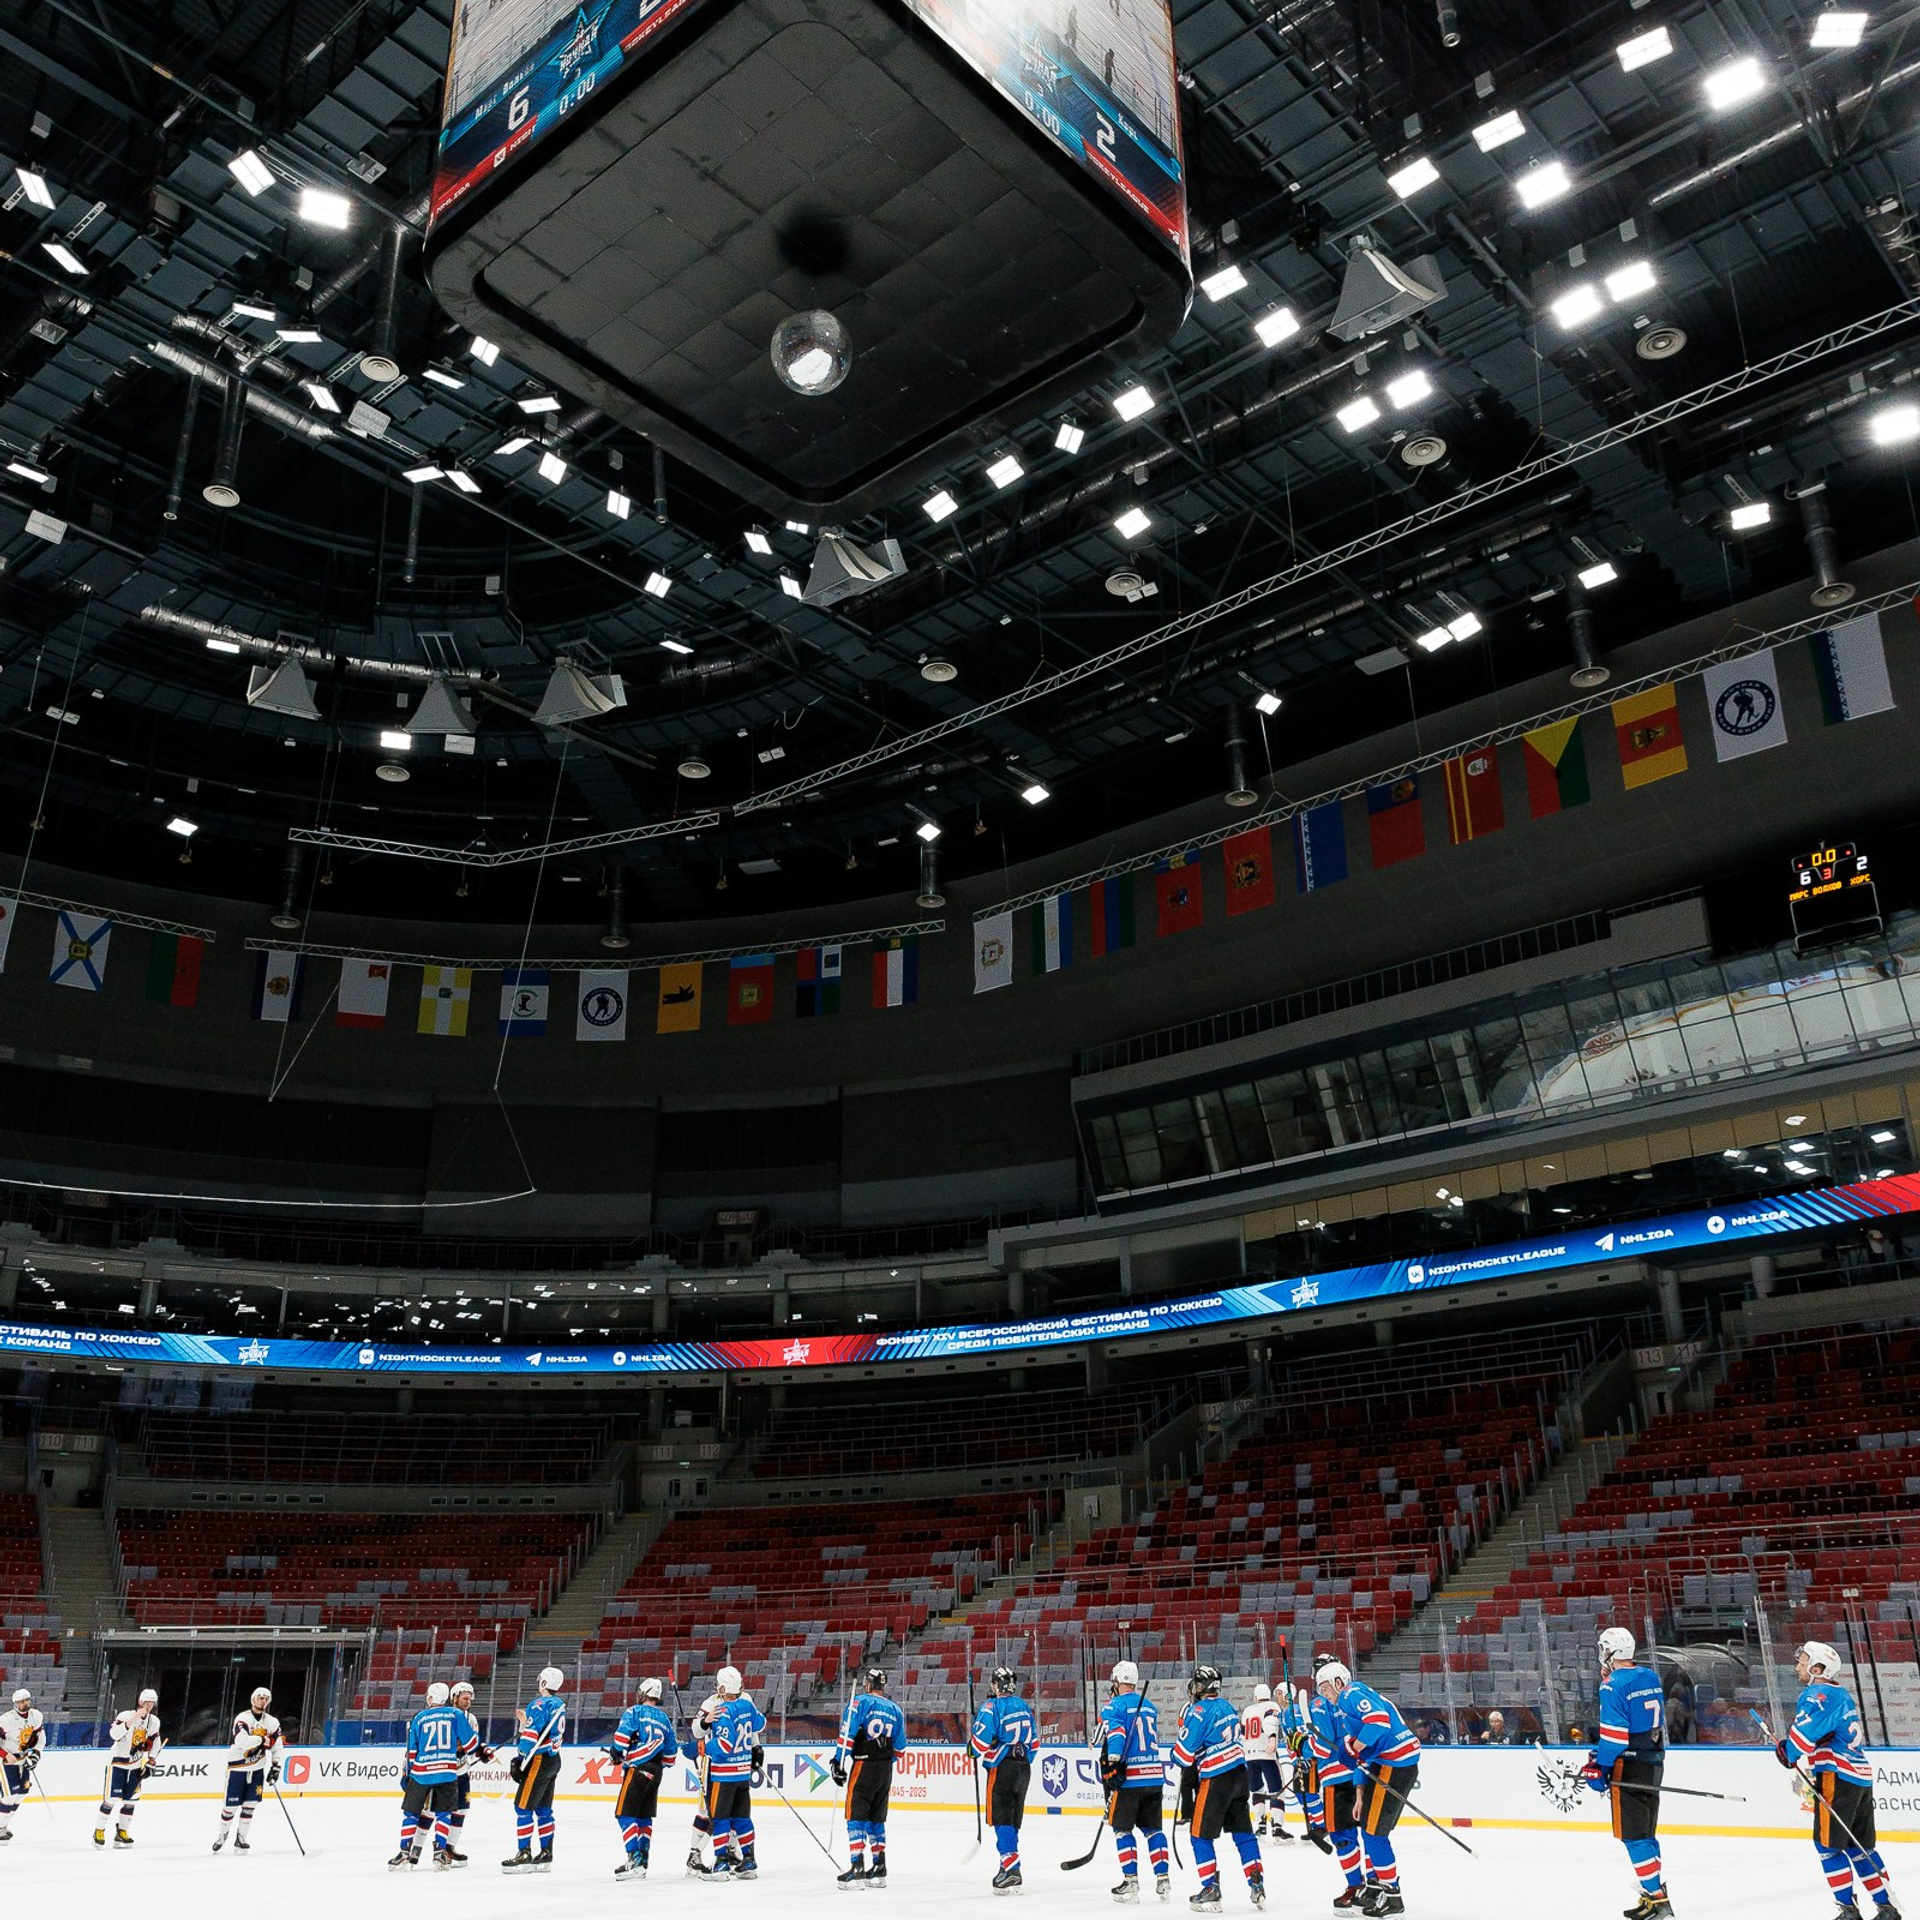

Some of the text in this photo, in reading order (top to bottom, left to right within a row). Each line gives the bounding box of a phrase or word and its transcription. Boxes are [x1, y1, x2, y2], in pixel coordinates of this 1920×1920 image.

[559, 72, 597, 116] 0:00
[507, 85, 531, 131] 6
[1024, 90, 1061, 137] 0:00
[1096, 111, 1116, 163] 2
[1812, 849, 1836, 867] 0.0
[1800, 856, 1868, 886] 6 3 2
[1731, 1209, 1790, 1227] NHLIGA
[1620, 1228, 1674, 1245] NHLIGA
[1428, 1246, 1566, 1276] NIGHTHOCKEYLEAGUE
[876, 1297, 1223, 1347] ФОНБЕТ XIV ВСЕРОССИЙСКИЙ ФЕСТИВАЛЬ ПО ХОККЕЮ
[6, 1336, 71, 1350] КОМАНД
[75, 1331, 97, 1341] ПО
[100, 1334, 161, 1346] ХОККЕЮ
[947, 1319, 1150, 1351] СРЕДИ ЛЮБИТЕЛЬСКИХ КОМАНД
[379, 1353, 502, 1363] NIGHTHOCKEYLEAGUE
[546, 1354, 588, 1363] NHLIGA
[630, 1353, 672, 1363] NHLIGA
[1638, 1348, 1662, 1365] 113
[702, 1444, 719, 1457] 112
[1357, 1699, 1372, 1713] 9
[1643, 1699, 1661, 1728] 7
[423, 1720, 452, 1752] 20
[716, 1725, 730, 1739] 28
[733, 1720, 753, 1754] 28
[1005, 1719, 1032, 1745] 77
[1136, 1715, 1160, 1752] 15
[1245, 1716, 1261, 1740] 10
[152, 1764, 209, 1778] БАНК
[319, 1762, 399, 1780] VK Видео
[896, 1752, 976, 1779] ОРДИМСЯ!
